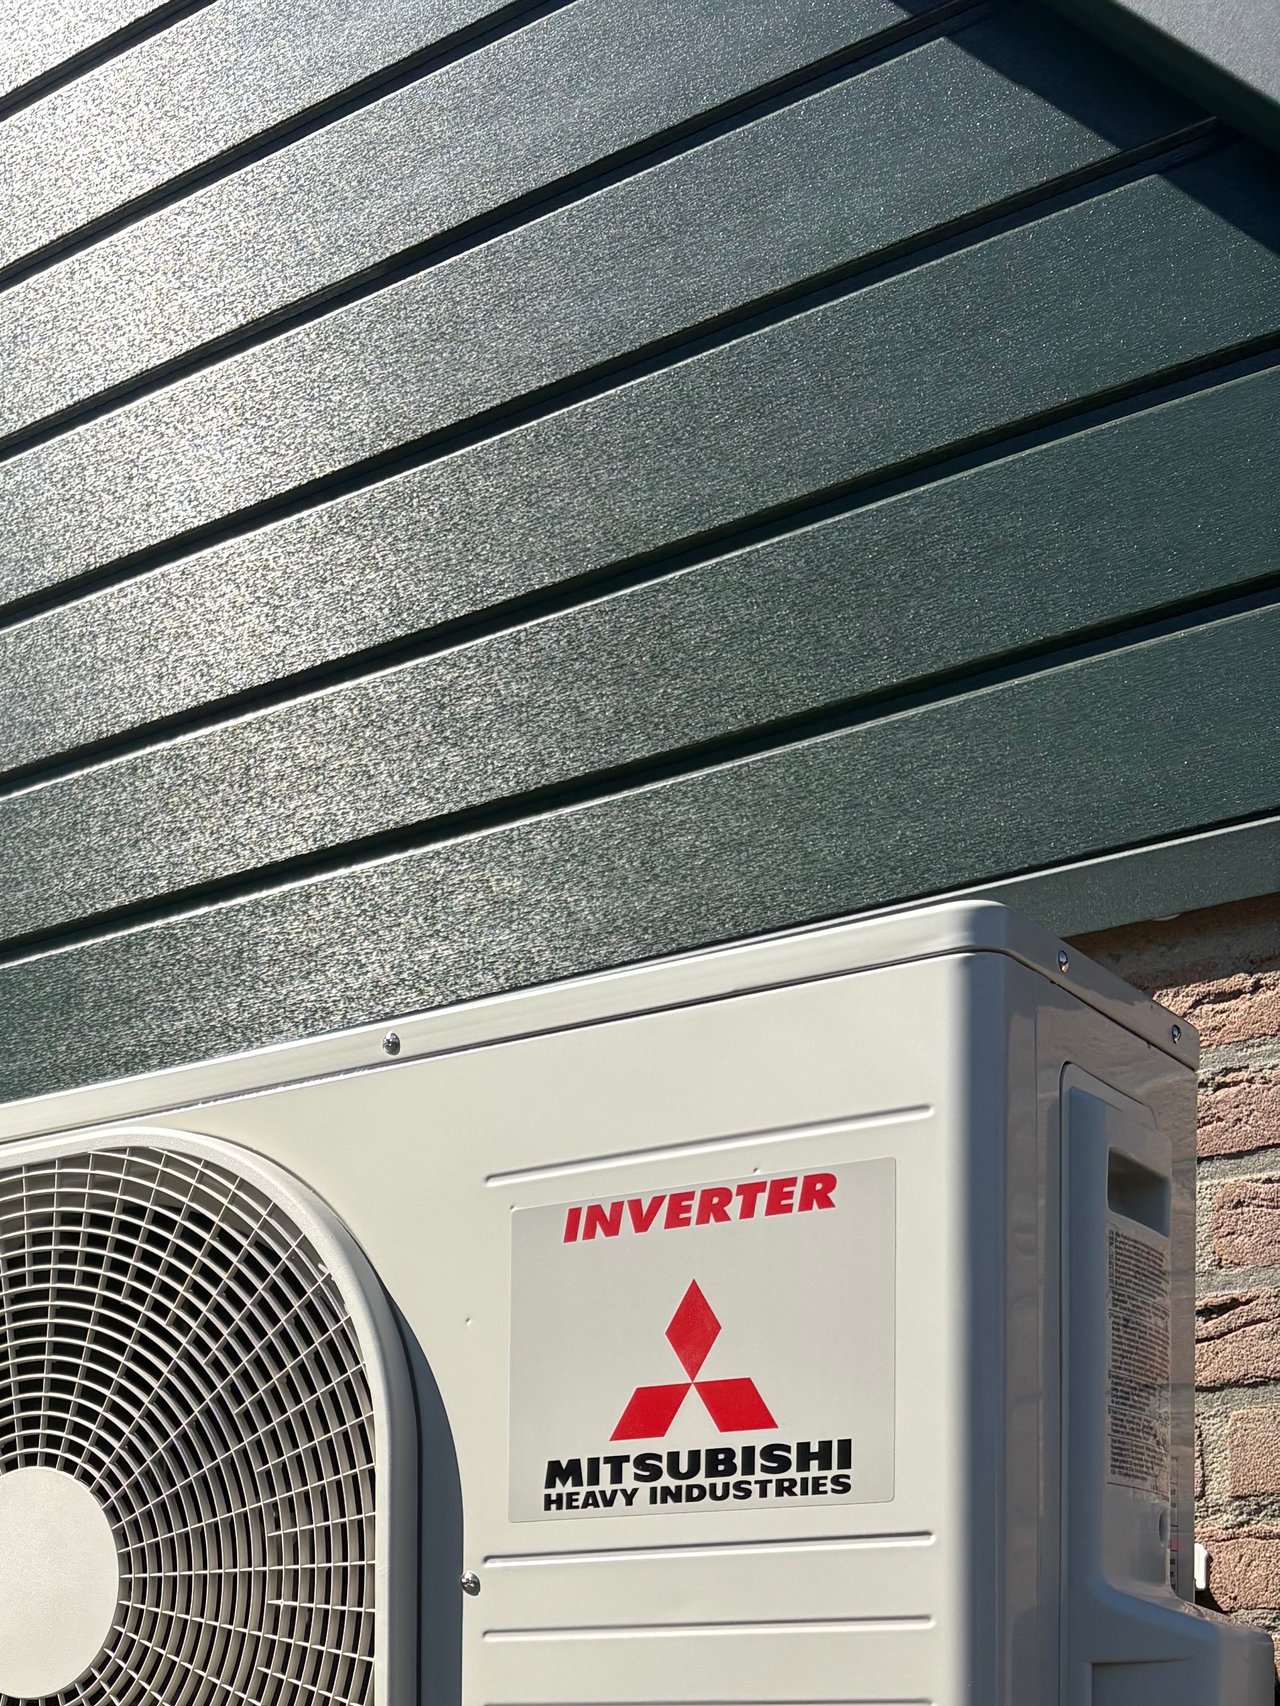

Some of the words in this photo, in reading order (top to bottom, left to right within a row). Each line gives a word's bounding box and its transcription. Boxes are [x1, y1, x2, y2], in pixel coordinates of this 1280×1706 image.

[563, 1172, 838, 1244] INVERTER
[543, 1438, 853, 1489] MITSUBISHI
[543, 1487, 639, 1512] HEAVY
[649, 1474, 852, 1505] INDUSTRIES
